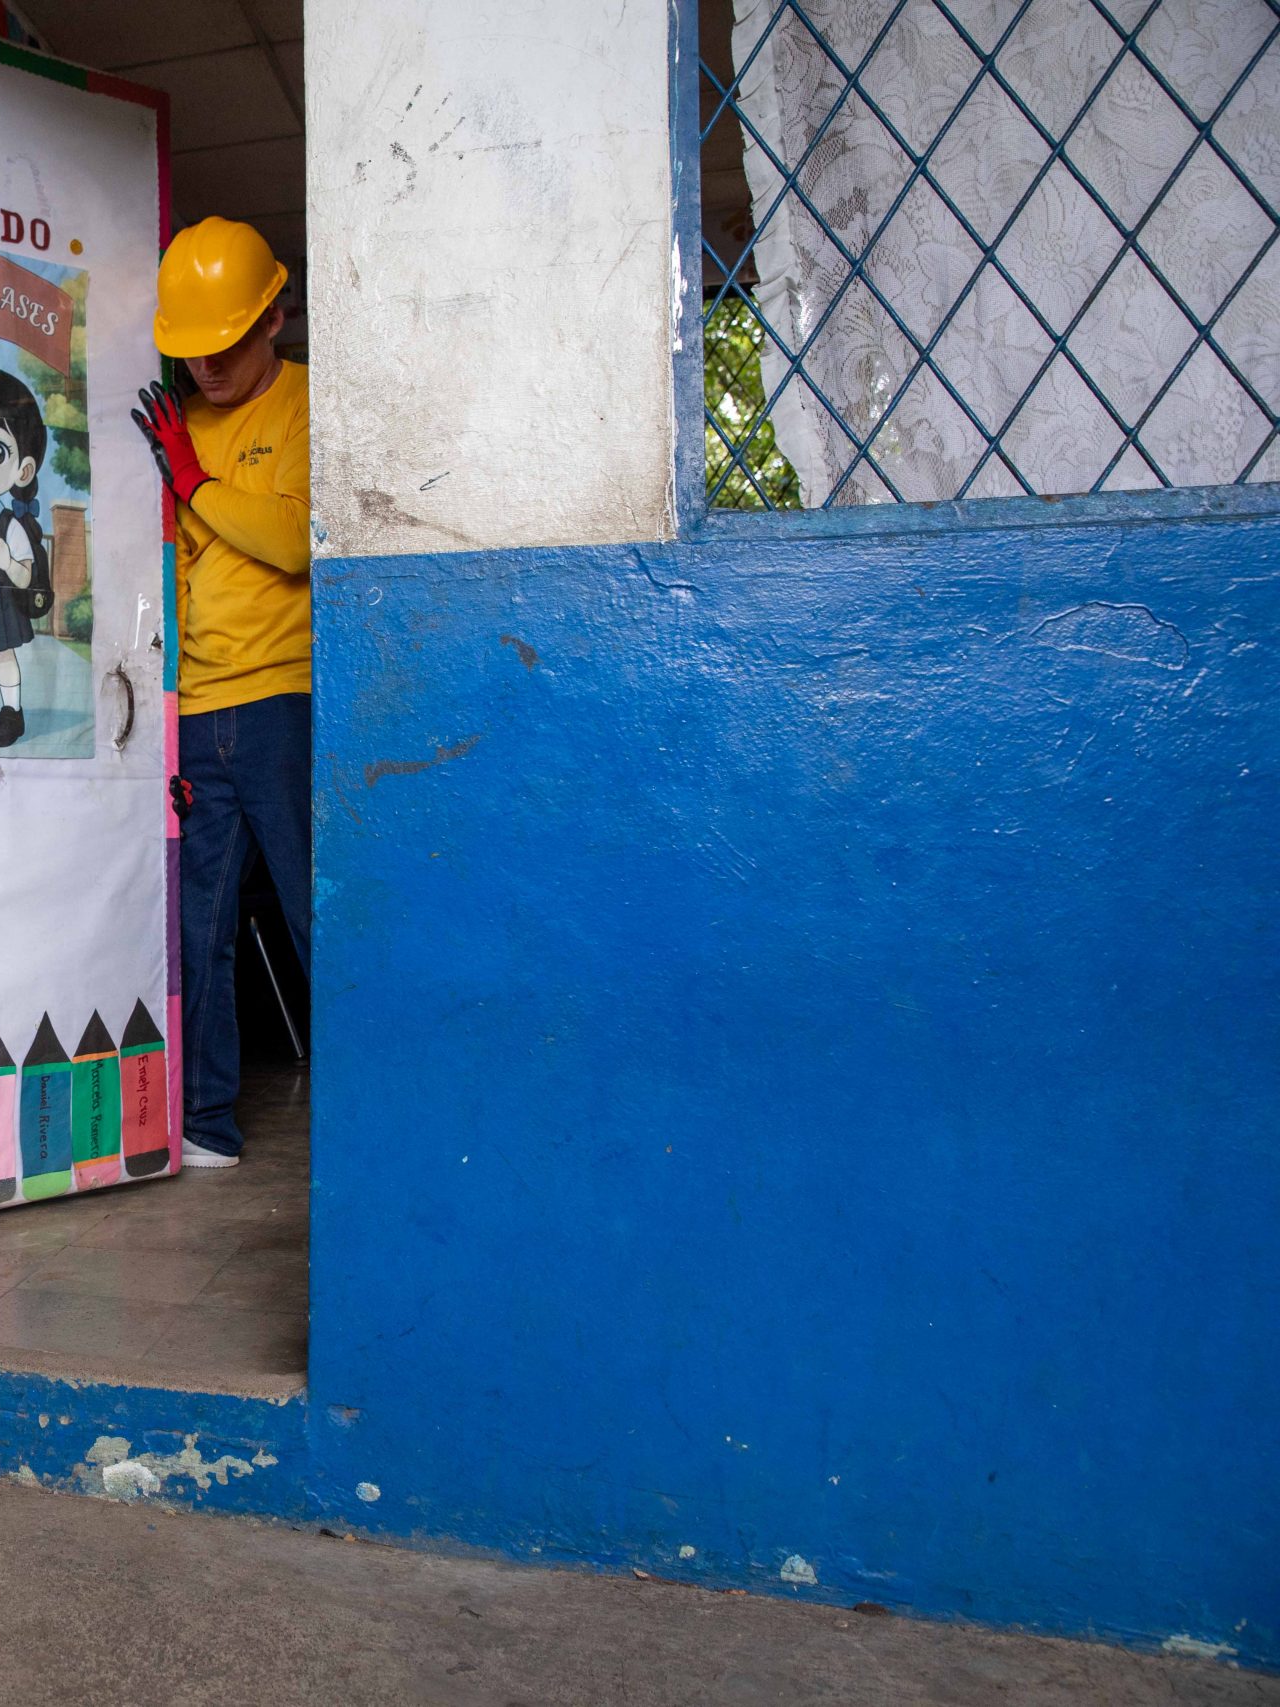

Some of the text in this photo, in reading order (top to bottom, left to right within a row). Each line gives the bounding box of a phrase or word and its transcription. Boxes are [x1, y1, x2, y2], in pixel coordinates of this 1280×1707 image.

[38, 1075, 51, 1160] Daniel Rivera
[89, 1059, 104, 1159] Marcela Romero
[136, 1055, 149, 1128] Emely Cruz
